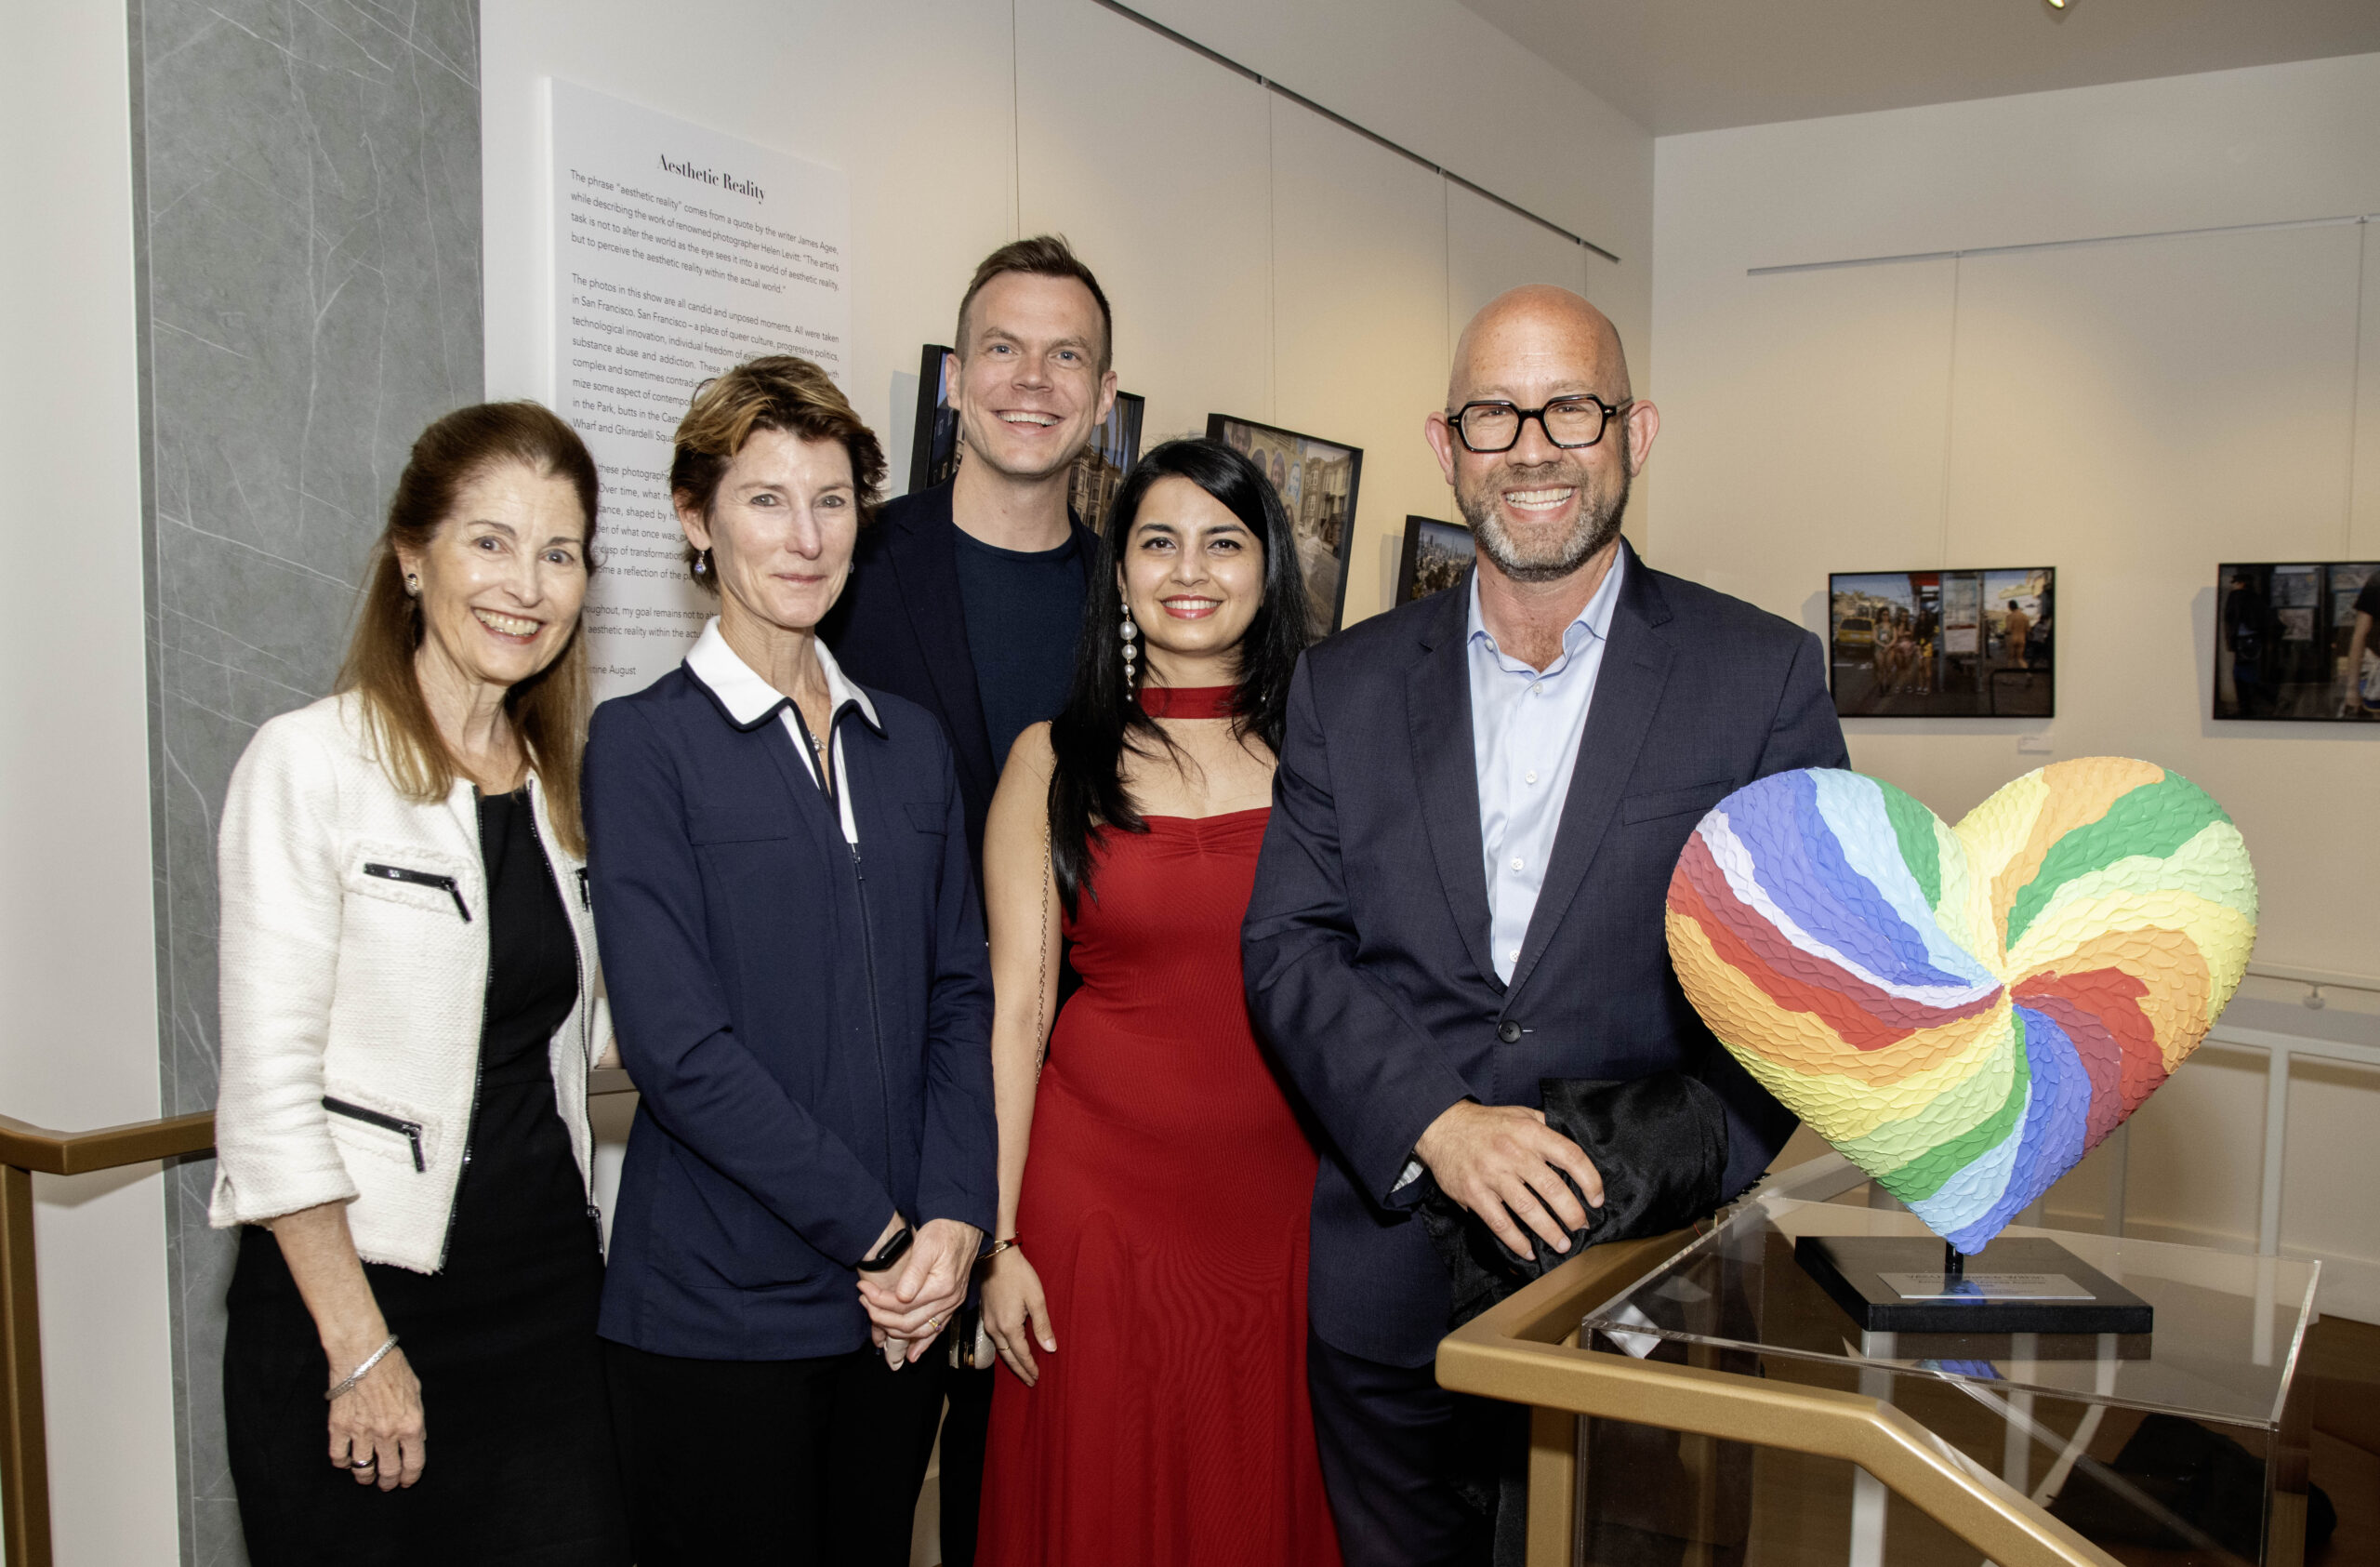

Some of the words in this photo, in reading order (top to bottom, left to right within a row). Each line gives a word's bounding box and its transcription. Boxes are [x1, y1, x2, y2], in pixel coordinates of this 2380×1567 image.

[656, 153, 719, 186] Aesthetic
[723, 173, 765, 205] Reality
[571, 169, 586, 182] The
[588, 176, 615, 191] phrase
[684, 204, 707, 218] comes
[709, 209, 725, 222] from
[734, 219, 754, 231] quote
[755, 224, 763, 234] by
[765, 226, 776, 236] the
[778, 231, 797, 243] writer
[798, 234, 818, 248] James
[820, 242, 839, 255] Agee,
[571, 192, 591, 205] while
[593, 199, 633, 219] describing
[635, 208, 647, 219] the
[648, 213, 666, 226] work
[667, 218, 674, 227] of
[676, 221, 712, 238] renowned
[713, 231, 760, 250] photographer
[761, 244, 780, 257] Helen
[571, 213, 587, 224] task
[589, 217, 596, 226] is
[598, 220, 610, 231] not
[613, 224, 621, 233] to
[622, 226, 640, 237] alter
[641, 231, 654, 242] the
[655, 234, 676, 247] world
[678, 242, 686, 250] as
[687, 243, 699, 254] the
[701, 248, 714, 259] eye
[716, 251, 731, 262] sees
[733, 256, 738, 264] it
[739, 256, 752, 268] into
[760, 263, 779, 274] world
[781, 268, 787, 276] of
[788, 270, 818, 285] aesthetic
[572, 232, 586, 246] but
[588, 237, 596, 246] to
[598, 241, 630, 256] perceive
[632, 248, 644, 259] the
[646, 253, 680, 269] aesthetic
[681, 262, 703, 276] reality
[705, 268, 725, 280] within
[727, 272, 739, 283] the
[740, 277, 760, 288] actual
[572, 272, 588, 286] The
[589, 278, 616, 293] photos
[619, 285, 626, 295] in
[628, 287, 641, 299] this
[643, 290, 662, 304] show
[665, 297, 676, 306] are
[678, 299, 686, 309] all
[688, 302, 712, 315] candid
[714, 309, 727, 318] and
[729, 312, 759, 325] unposed
[760, 319, 793, 333] moments.
[795, 325, 803, 335] All
[805, 329, 820, 339] were
[823, 332, 839, 343] taken
[573, 294, 579, 304] in
[582, 296, 596, 308] San
[638, 309, 651, 320] San
[653, 312, 687, 328] Francisco
[700, 324, 720, 336] place
[721, 327, 729, 337] of
[730, 331, 749, 341] queer
[751, 335, 775, 348] culture,
[777, 341, 813, 355] progressive
[815, 349, 839, 362] politics,
[573, 316, 625, 334] technological
[627, 328, 668, 344] innovation,
[669, 335, 703, 351] individual
[705, 343, 734, 358] freedom
[735, 349, 743, 358] of
[573, 337, 613, 352] substance
[615, 345, 639, 357] abuse
[641, 352, 656, 361] and
[659, 353, 696, 369] addiction.
[699, 361, 721, 372] These
[573, 358, 606, 372] complex
[608, 365, 622, 375] and
[624, 368, 664, 382] sometimes
[573, 378, 591, 389] mize
[593, 382, 614, 392] some
[616, 387, 641, 398] aspect
[643, 391, 651, 400] of
[573, 397, 580, 407] in
[582, 399, 595, 409] the
[598, 402, 615, 414] Park,
[618, 406, 638, 418] butts
[640, 410, 645, 418] in
[648, 411, 660, 420] the
[573, 418, 596, 431] Wharf
[599, 422, 614, 433] and
[615, 425, 654, 440] Ghirardelli
[655, 432, 676, 444] Squa
[599, 463, 619, 474] these
[599, 483, 617, 494] Over
[620, 486, 640, 498] time,
[642, 490, 661, 500] what
[627, 507, 654, 520] shaped
[658, 510, 667, 522] by
[611, 525, 619, 534] of
[621, 526, 640, 537] what
[641, 530, 659, 539] once
[662, 533, 678, 542] was,
[621, 546, 628, 555] of
[624, 566, 659, 578] reflection
[661, 569, 668, 578] of
[670, 569, 681, 580] the
[622, 608, 633, 618] my
[636, 607, 653, 618] goal
[654, 609, 681, 618] remains
[683, 610, 695, 619] not
[697, 610, 705, 619] to
[588, 625, 622, 635] aesthetic
[624, 627, 647, 638] reality
[649, 628, 670, 637] within
[672, 629, 683, 638] the
[686, 631, 702, 639] actu
[609, 664, 636, 677] August
